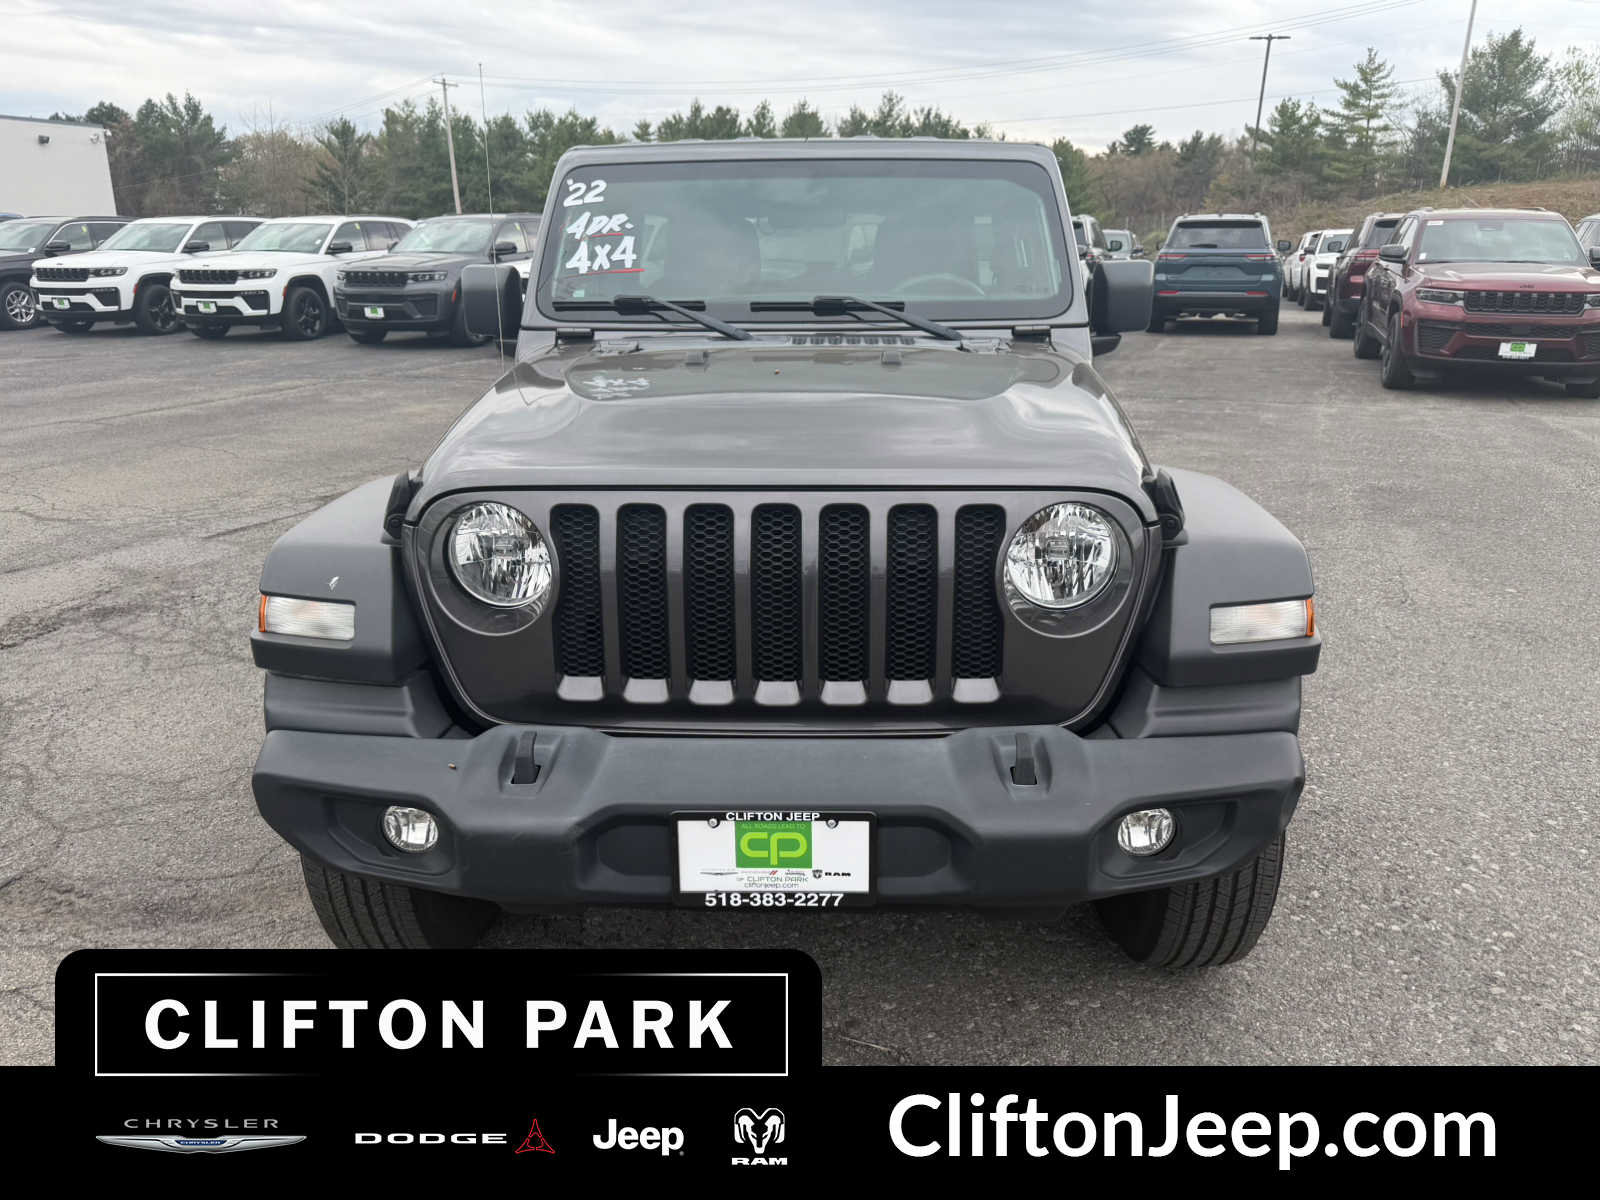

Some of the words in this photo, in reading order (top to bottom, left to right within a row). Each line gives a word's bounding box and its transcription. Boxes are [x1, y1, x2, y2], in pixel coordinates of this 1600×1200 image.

[563, 178, 607, 207] '22
[725, 812, 783, 821] CLIFTON
[785, 812, 820, 821] JEEP
[704, 893, 844, 907] 518-383-2277
